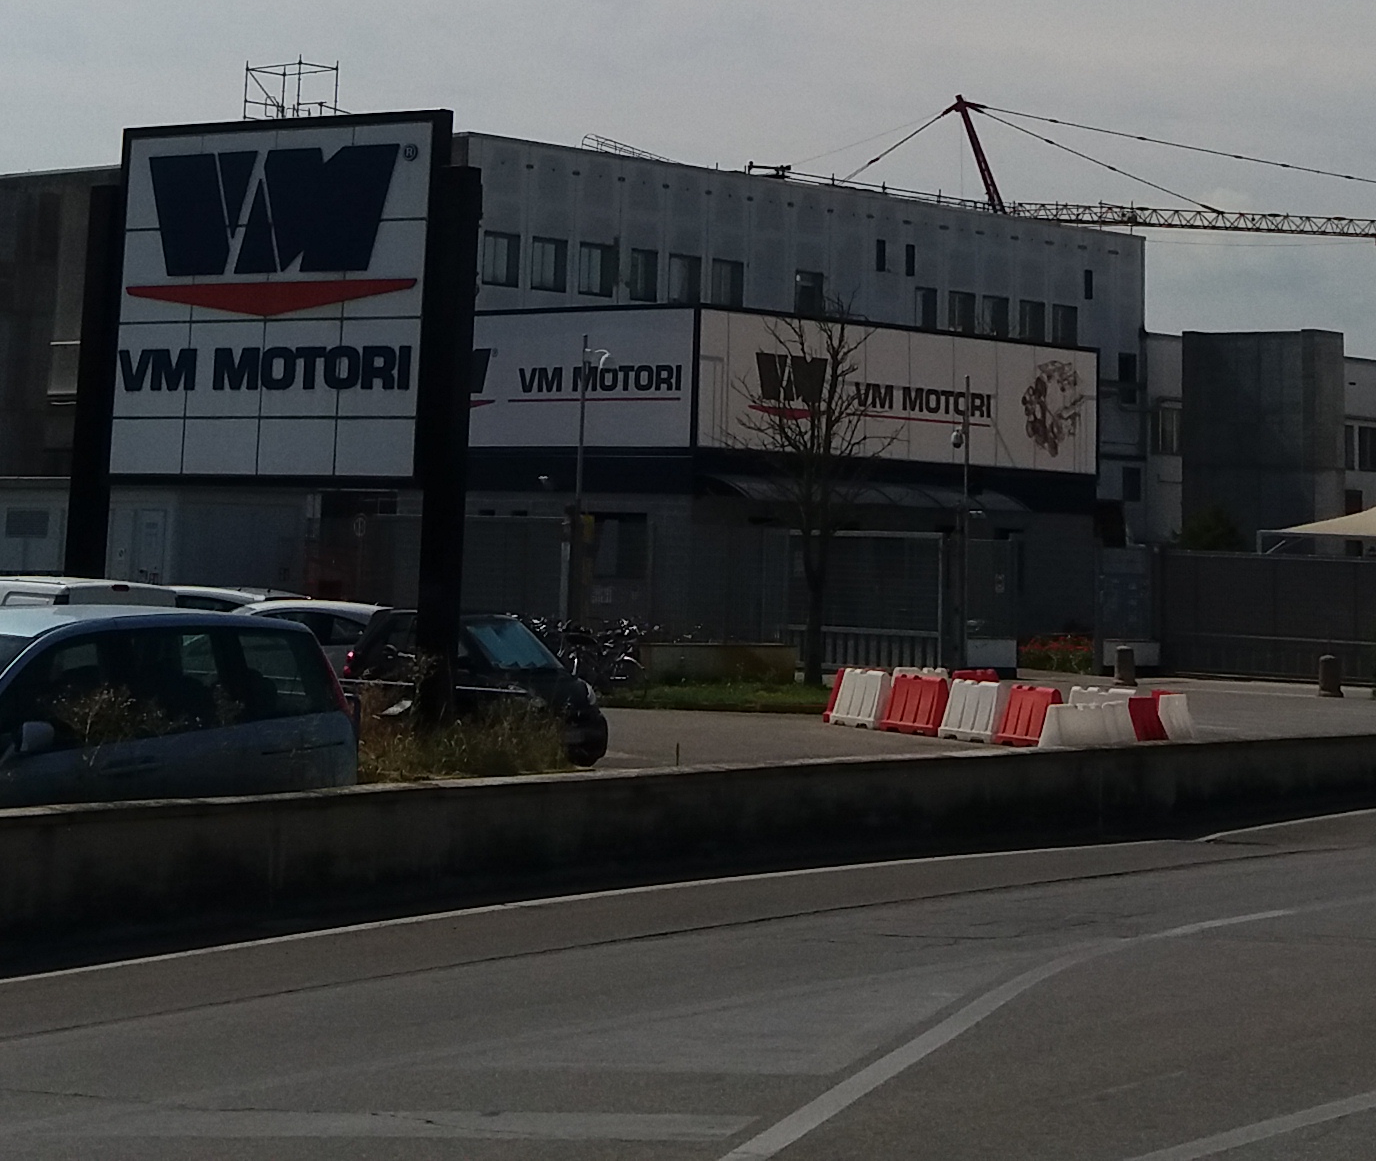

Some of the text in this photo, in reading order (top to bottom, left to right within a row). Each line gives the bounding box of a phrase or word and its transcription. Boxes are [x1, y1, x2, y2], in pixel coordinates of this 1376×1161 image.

[118, 347, 198, 392] VM
[212, 345, 413, 391] MOTORI
[518, 367, 563, 393] VM
[572, 364, 683, 392] MOTORI
[854, 382, 992, 419] VM MOTORI
